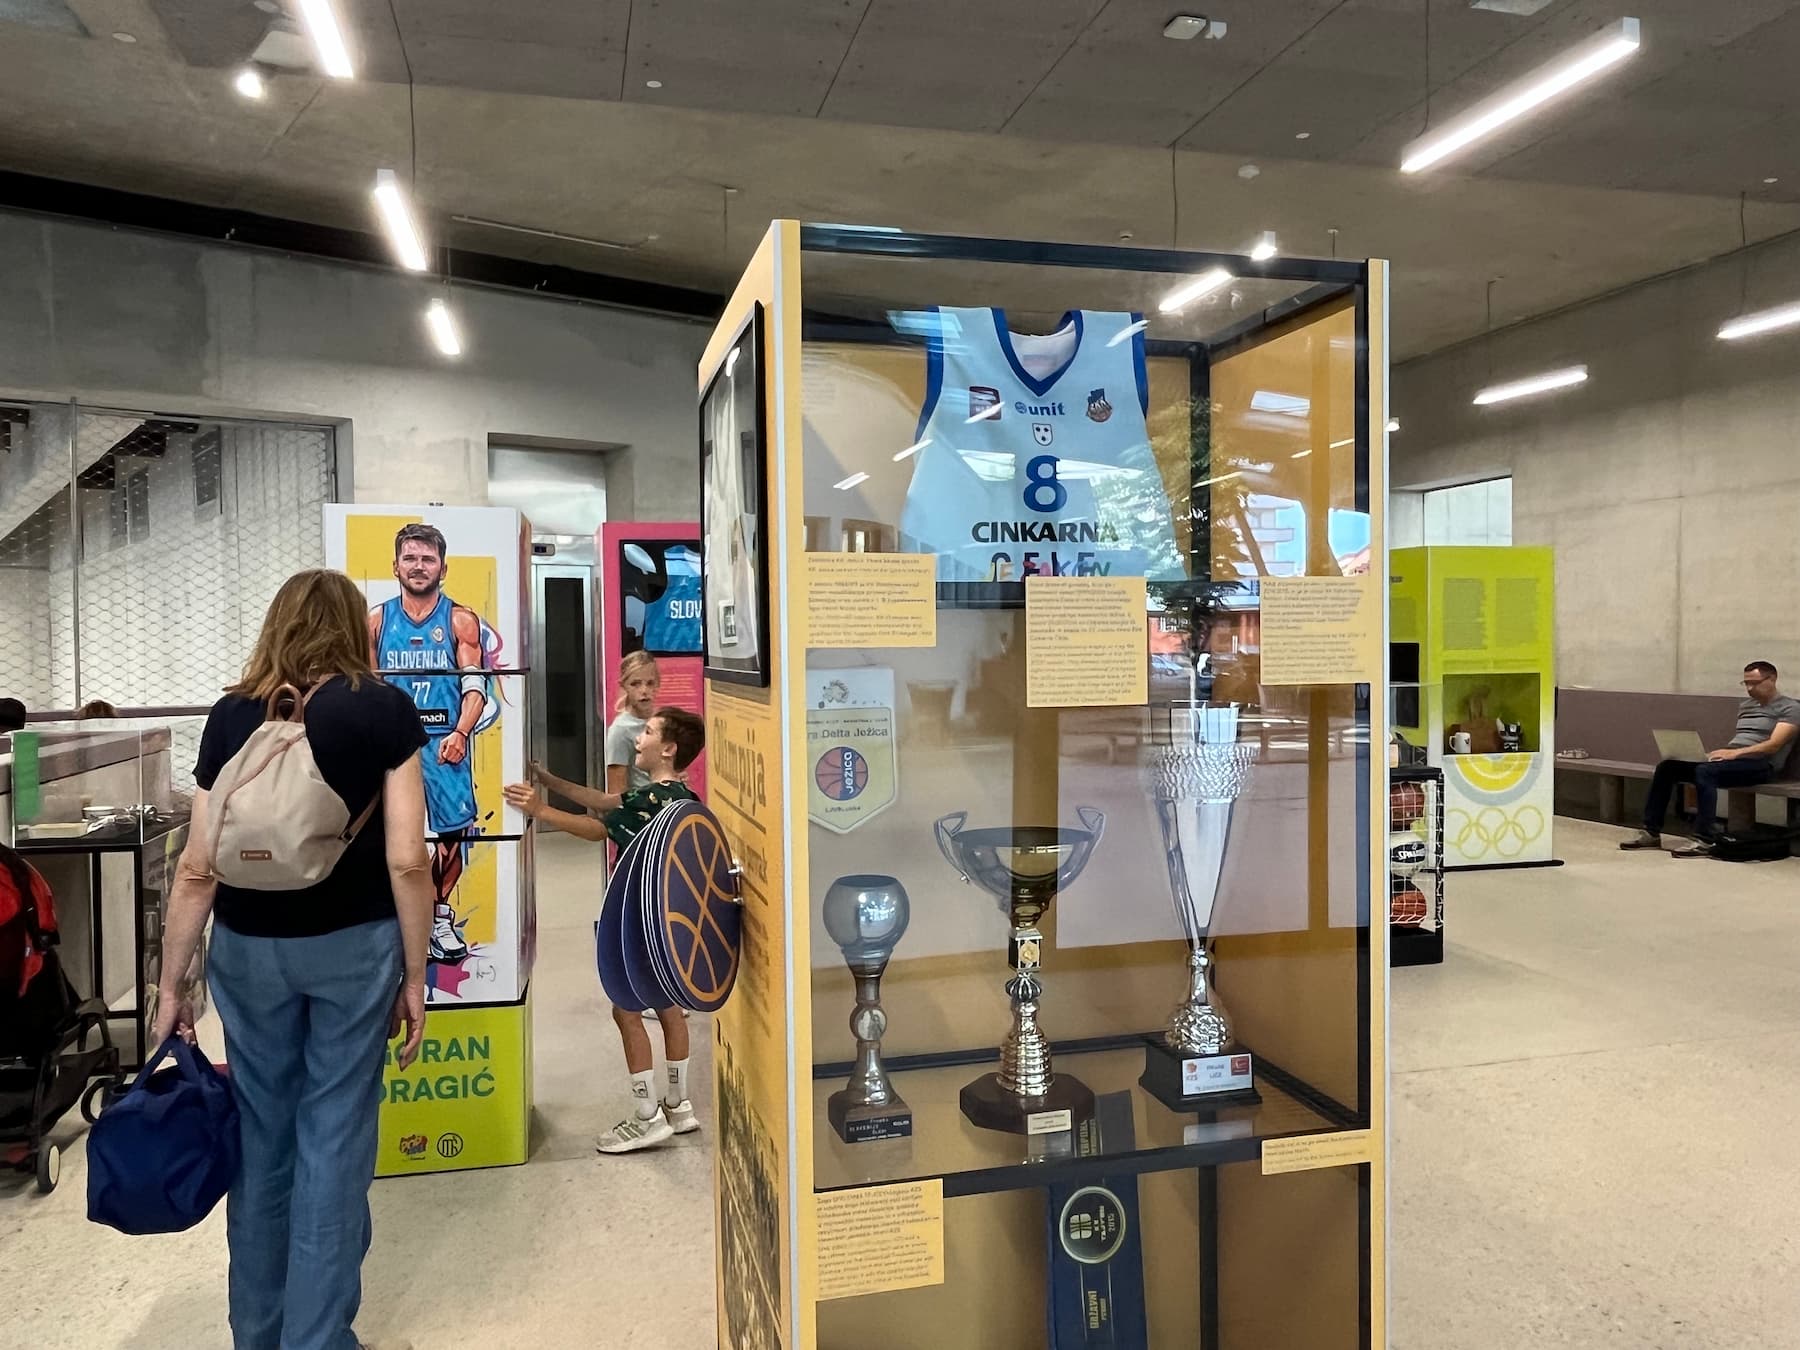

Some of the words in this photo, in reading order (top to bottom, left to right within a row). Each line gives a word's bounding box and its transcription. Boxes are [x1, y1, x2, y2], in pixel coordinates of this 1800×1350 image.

[1027, 402, 1065, 416] unit
[1023, 454, 1068, 512] 8
[971, 521, 1119, 543] CINKARNA
[386, 649, 449, 670] SLOVENIJA
[411, 681, 431, 704] 77
